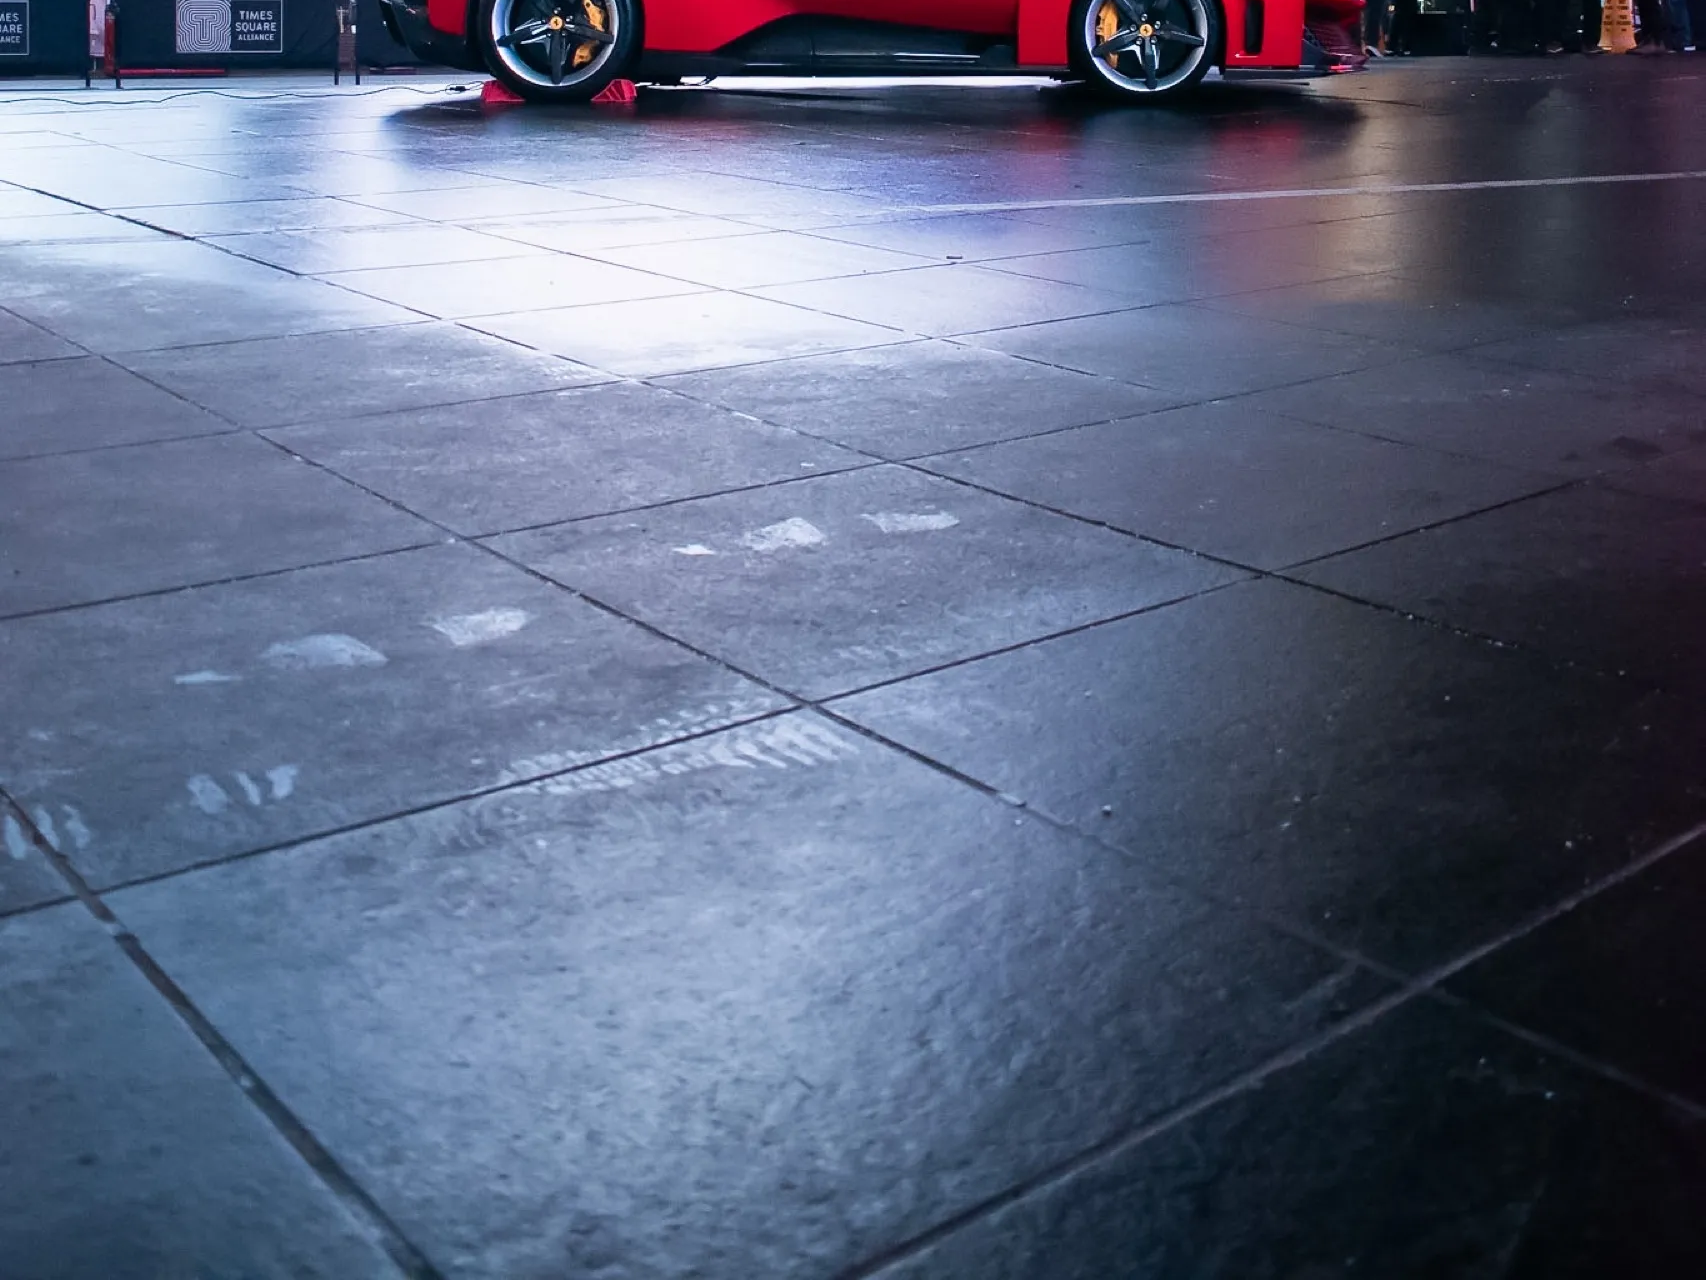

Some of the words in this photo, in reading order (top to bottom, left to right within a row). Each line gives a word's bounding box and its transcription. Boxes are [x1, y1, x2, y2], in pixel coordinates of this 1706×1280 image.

[239, 10, 274, 21] TIMES
[235, 22, 278, 33] SQUARE
[237, 33, 275, 41] ALLIANCE
